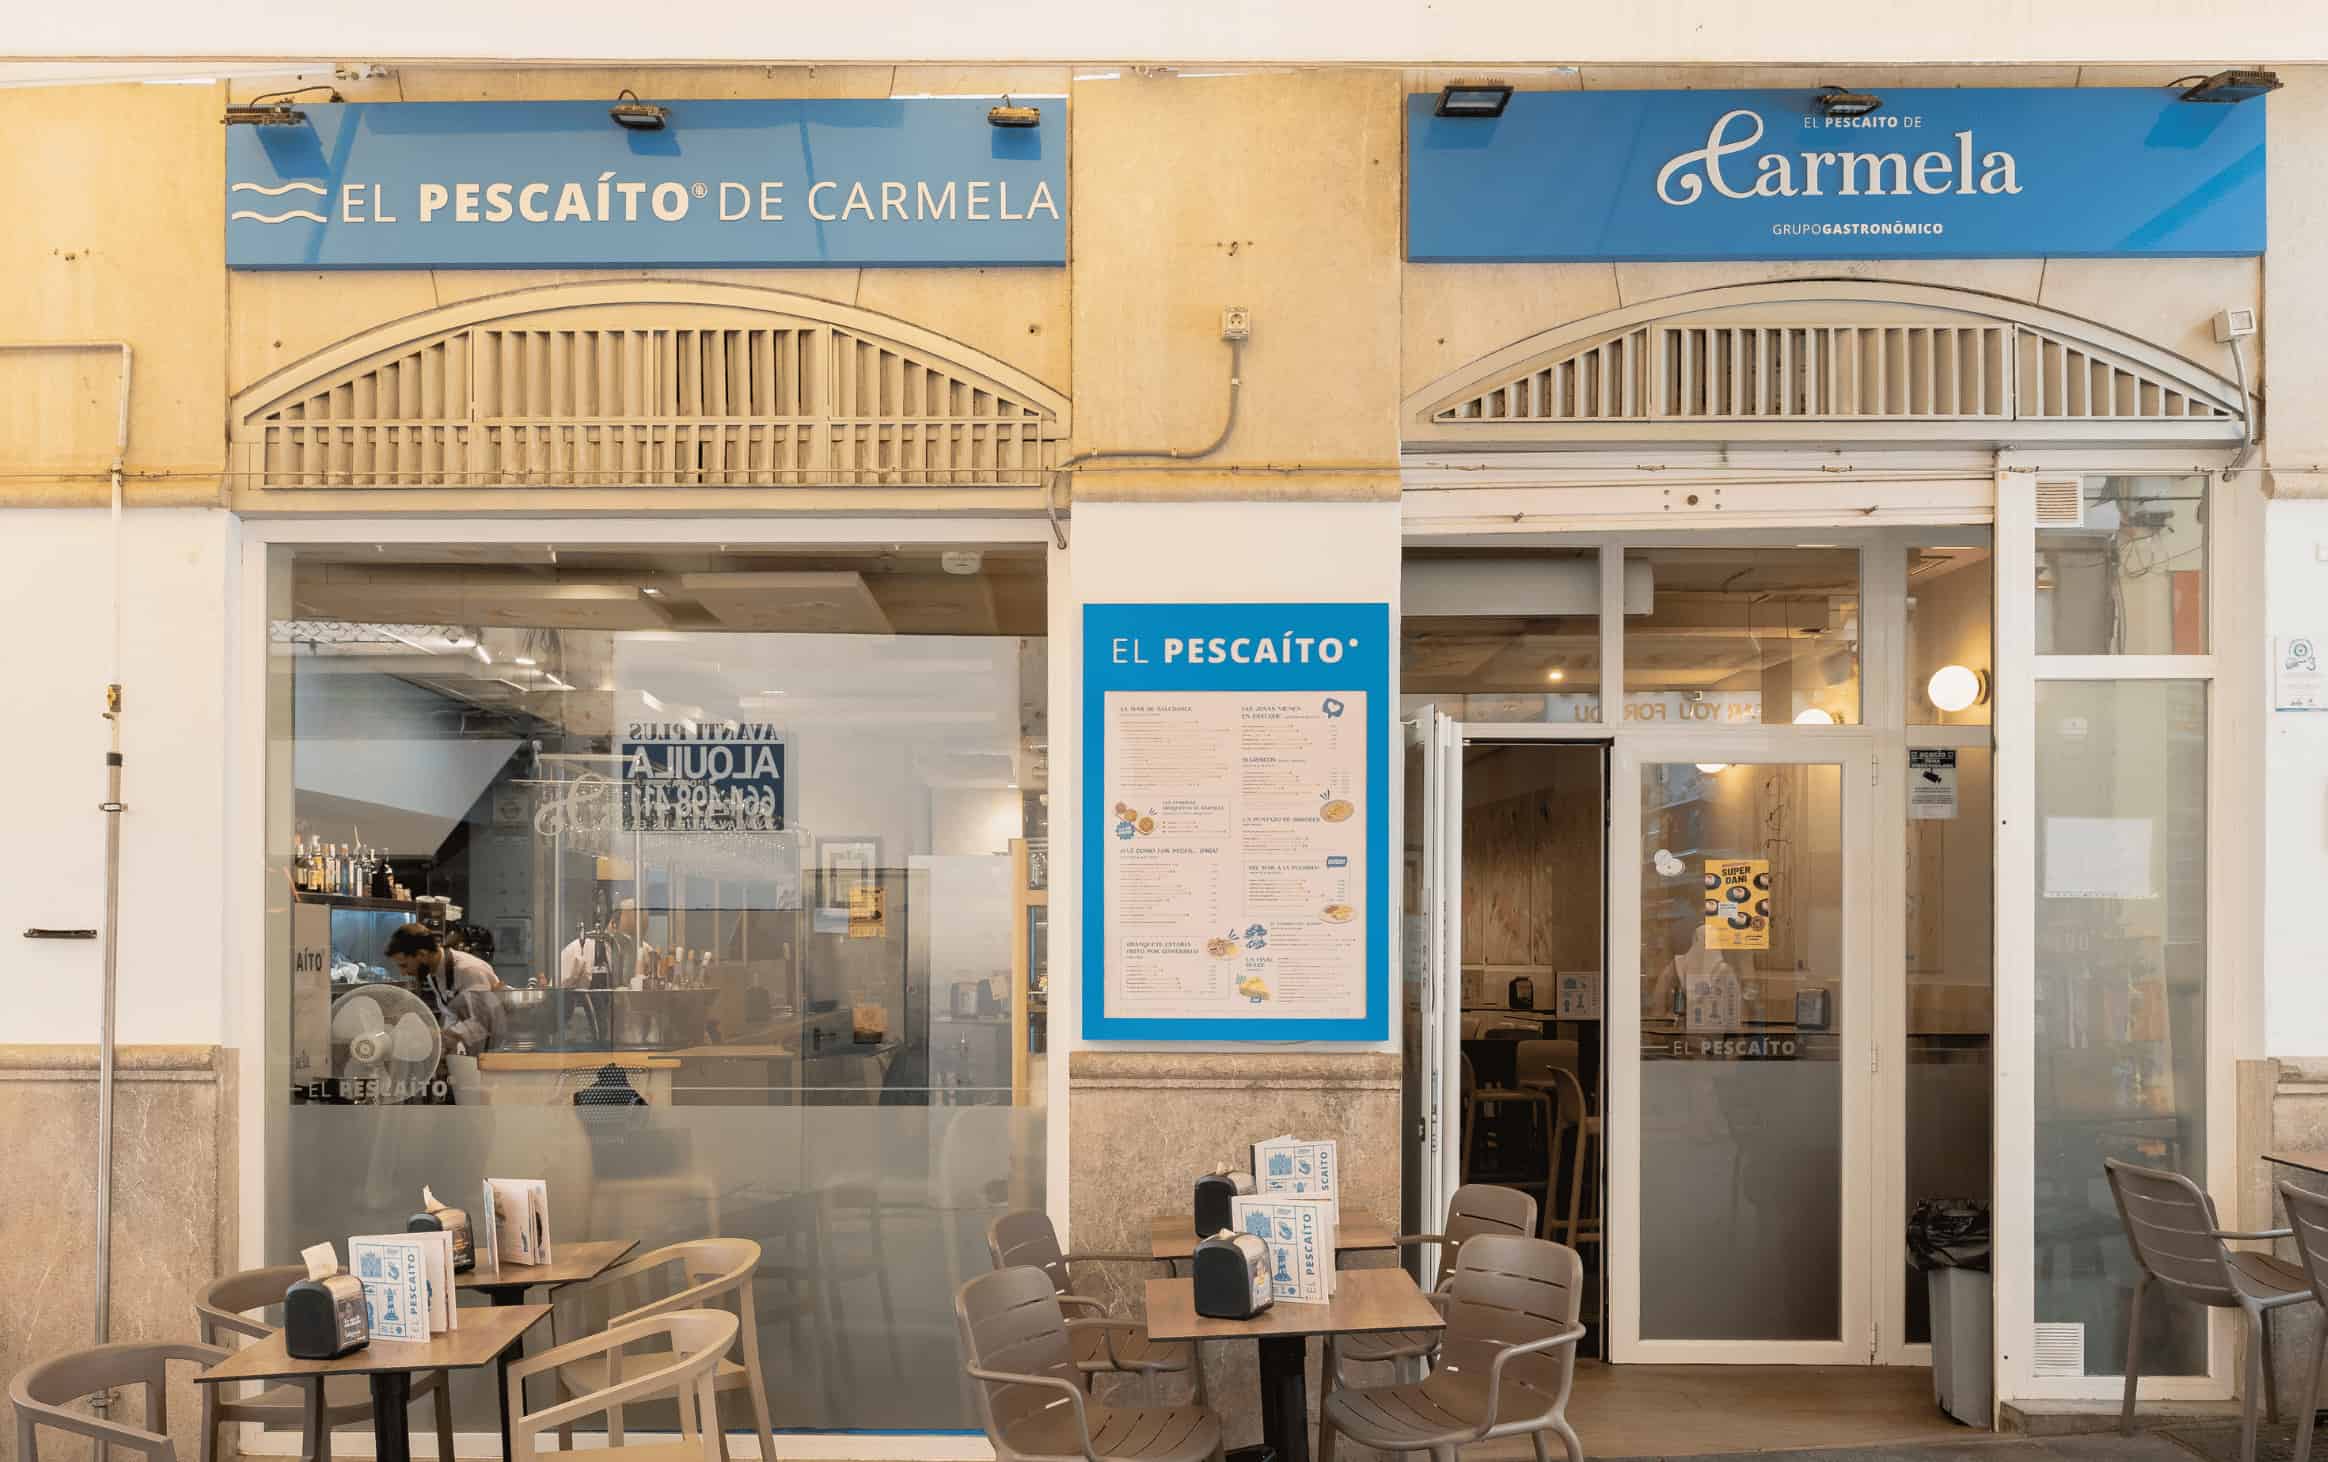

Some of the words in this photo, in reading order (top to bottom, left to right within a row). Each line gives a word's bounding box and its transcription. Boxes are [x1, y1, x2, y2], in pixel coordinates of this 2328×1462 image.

[1803, 116, 1819, 128] EL
[1903, 116, 1921, 128] DE
[1656, 109, 2023, 206] Carmela
[342, 183, 397, 222] EL
[719, 181, 784, 221] DE
[807, 181, 1060, 221] CARMELA
[1112, 638, 1149, 664] EL
[1721, 866, 1751, 876] SUPER
[1673, 1040, 1691, 1056] EL
[308, 1080, 331, 1097] EL
